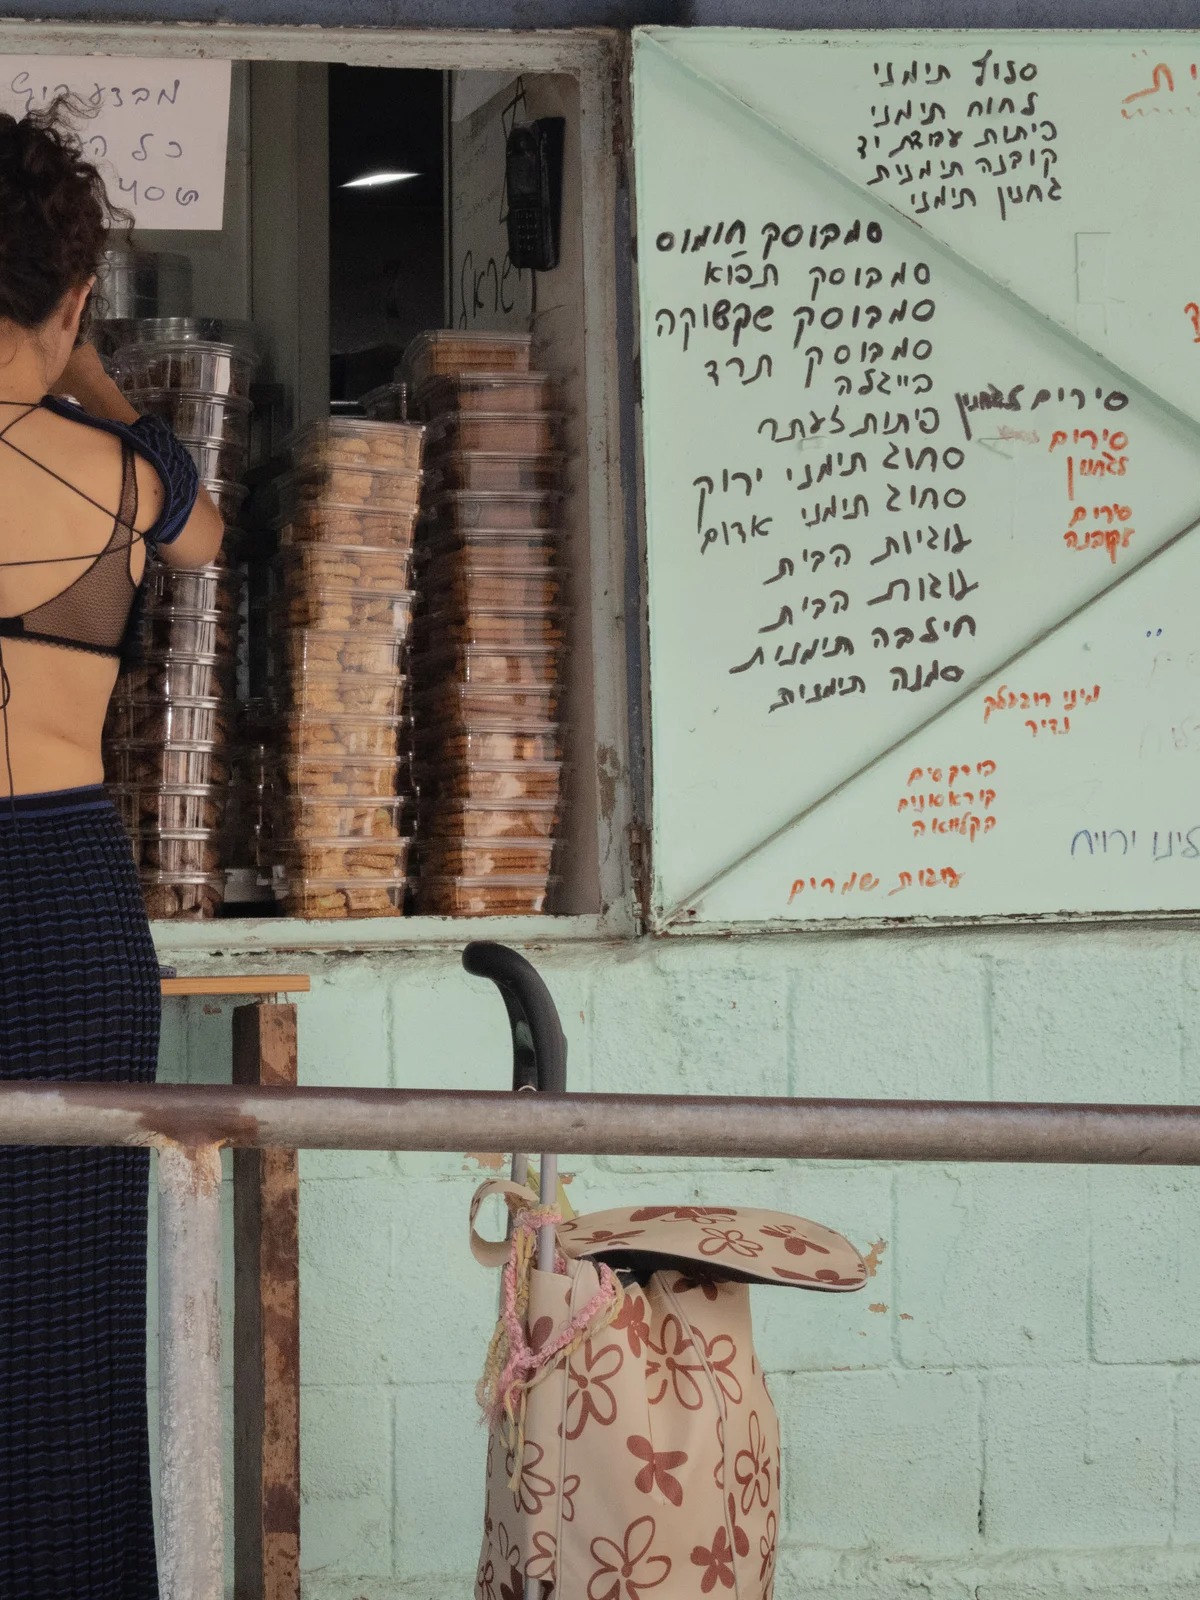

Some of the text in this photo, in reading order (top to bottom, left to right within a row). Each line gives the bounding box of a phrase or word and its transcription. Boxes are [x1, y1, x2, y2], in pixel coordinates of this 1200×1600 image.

[873, 60, 951, 87] תימני
[871, 92, 1038, 128] לחוח תימני
[857, 135, 880, 159] יד
[866, 148, 1057, 185] קובנה תימנית
[911, 177, 1062, 220] גחנון תימני
[655, 219, 883, 260] סמבוסק חומוס
[808, 262, 931, 301] סמבוסק
[655, 299, 936, 352] סמבוסק שקשוקה
[704, 337, 933, 389] סמבוסק תרד
[834, 368, 933, 396] בייגלה
[1031, 386, 1129, 412] סירים
[849, 406, 940, 438] פיתות
[1048, 428, 1129, 453] סירים
[692, 442, 965, 534] סחוג תימני ירוק
[699, 483, 967, 555] סחוג תימני אדום
[762, 523, 973, 586] עוגיות הבית
[757, 568, 980, 634] עוגות הבית
[728, 614, 977, 675] חילבה תימנית
[767, 659, 965, 714] סמנה תימנית
